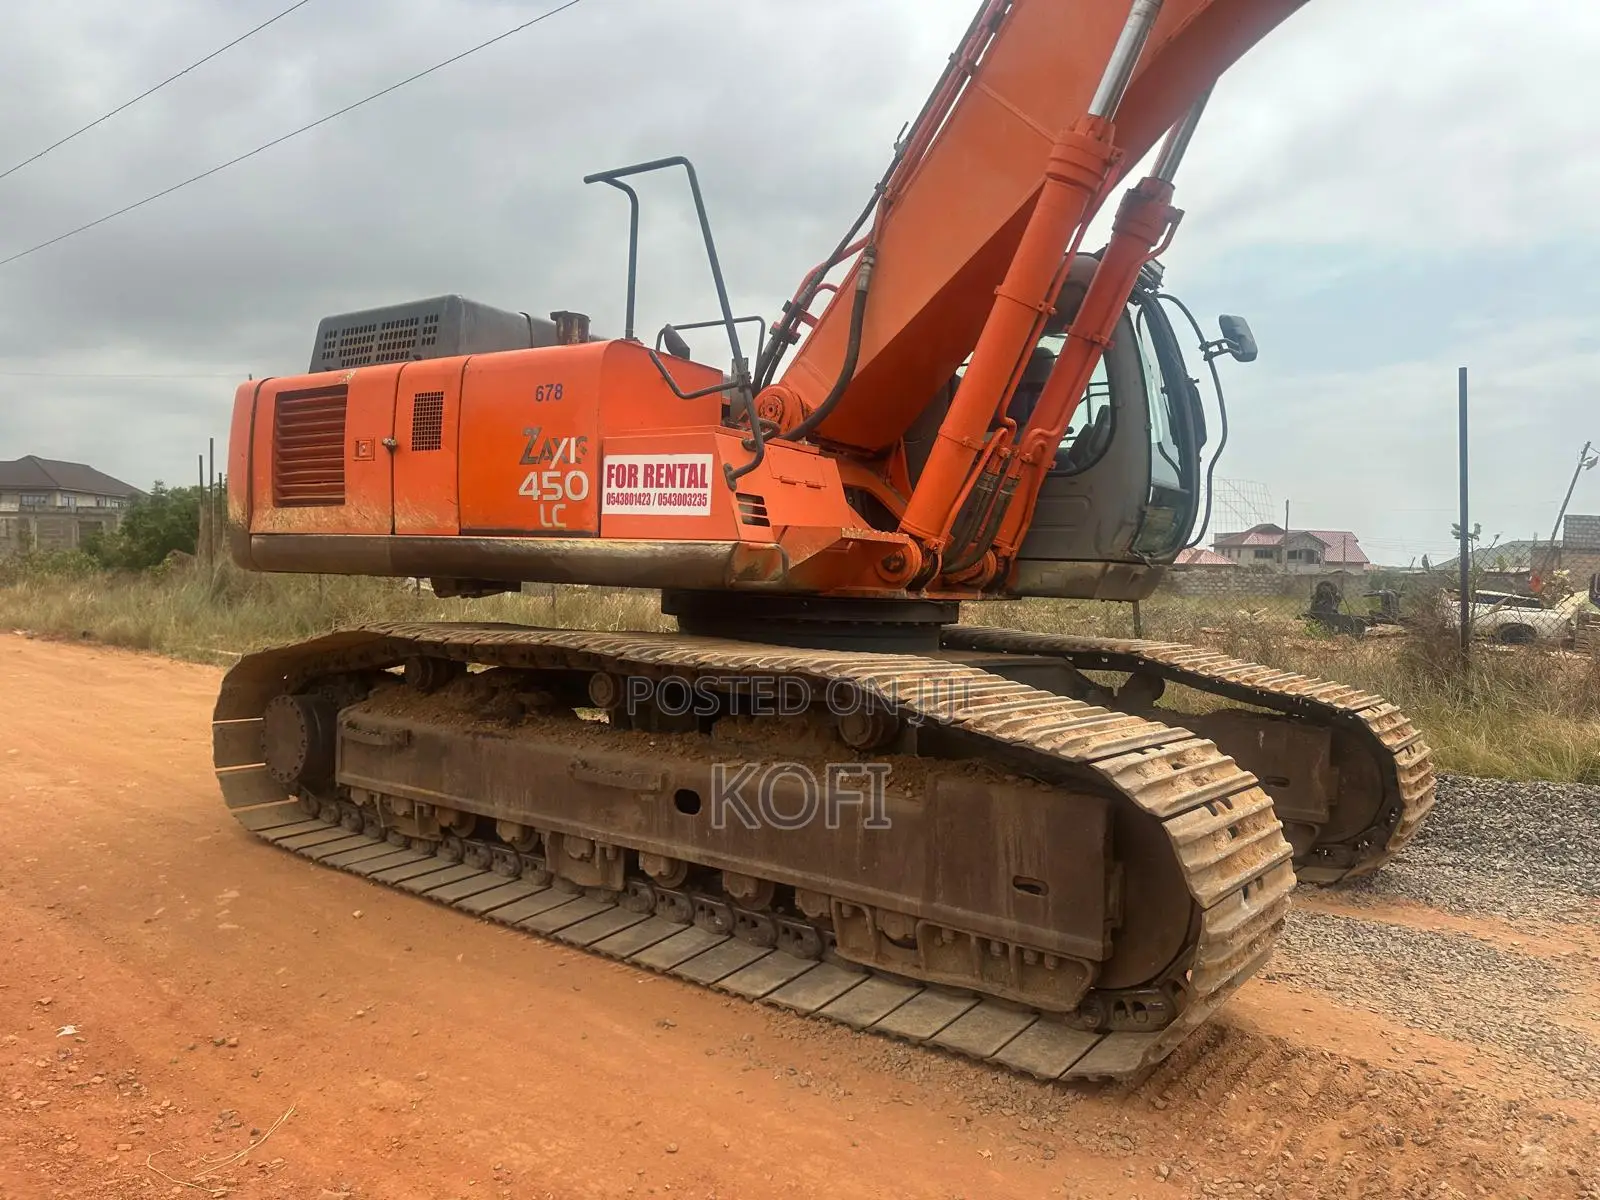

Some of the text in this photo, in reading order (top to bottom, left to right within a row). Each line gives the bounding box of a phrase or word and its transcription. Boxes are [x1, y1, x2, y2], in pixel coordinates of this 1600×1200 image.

[535, 383, 563, 402] 678
[518, 470, 589, 501] 450
[606, 463, 709, 489] FOR RENTAL
[605, 492, 651, 506] 0543801423
[657, 492, 708, 507] 0543003235
[539, 503, 567, 528] LC
